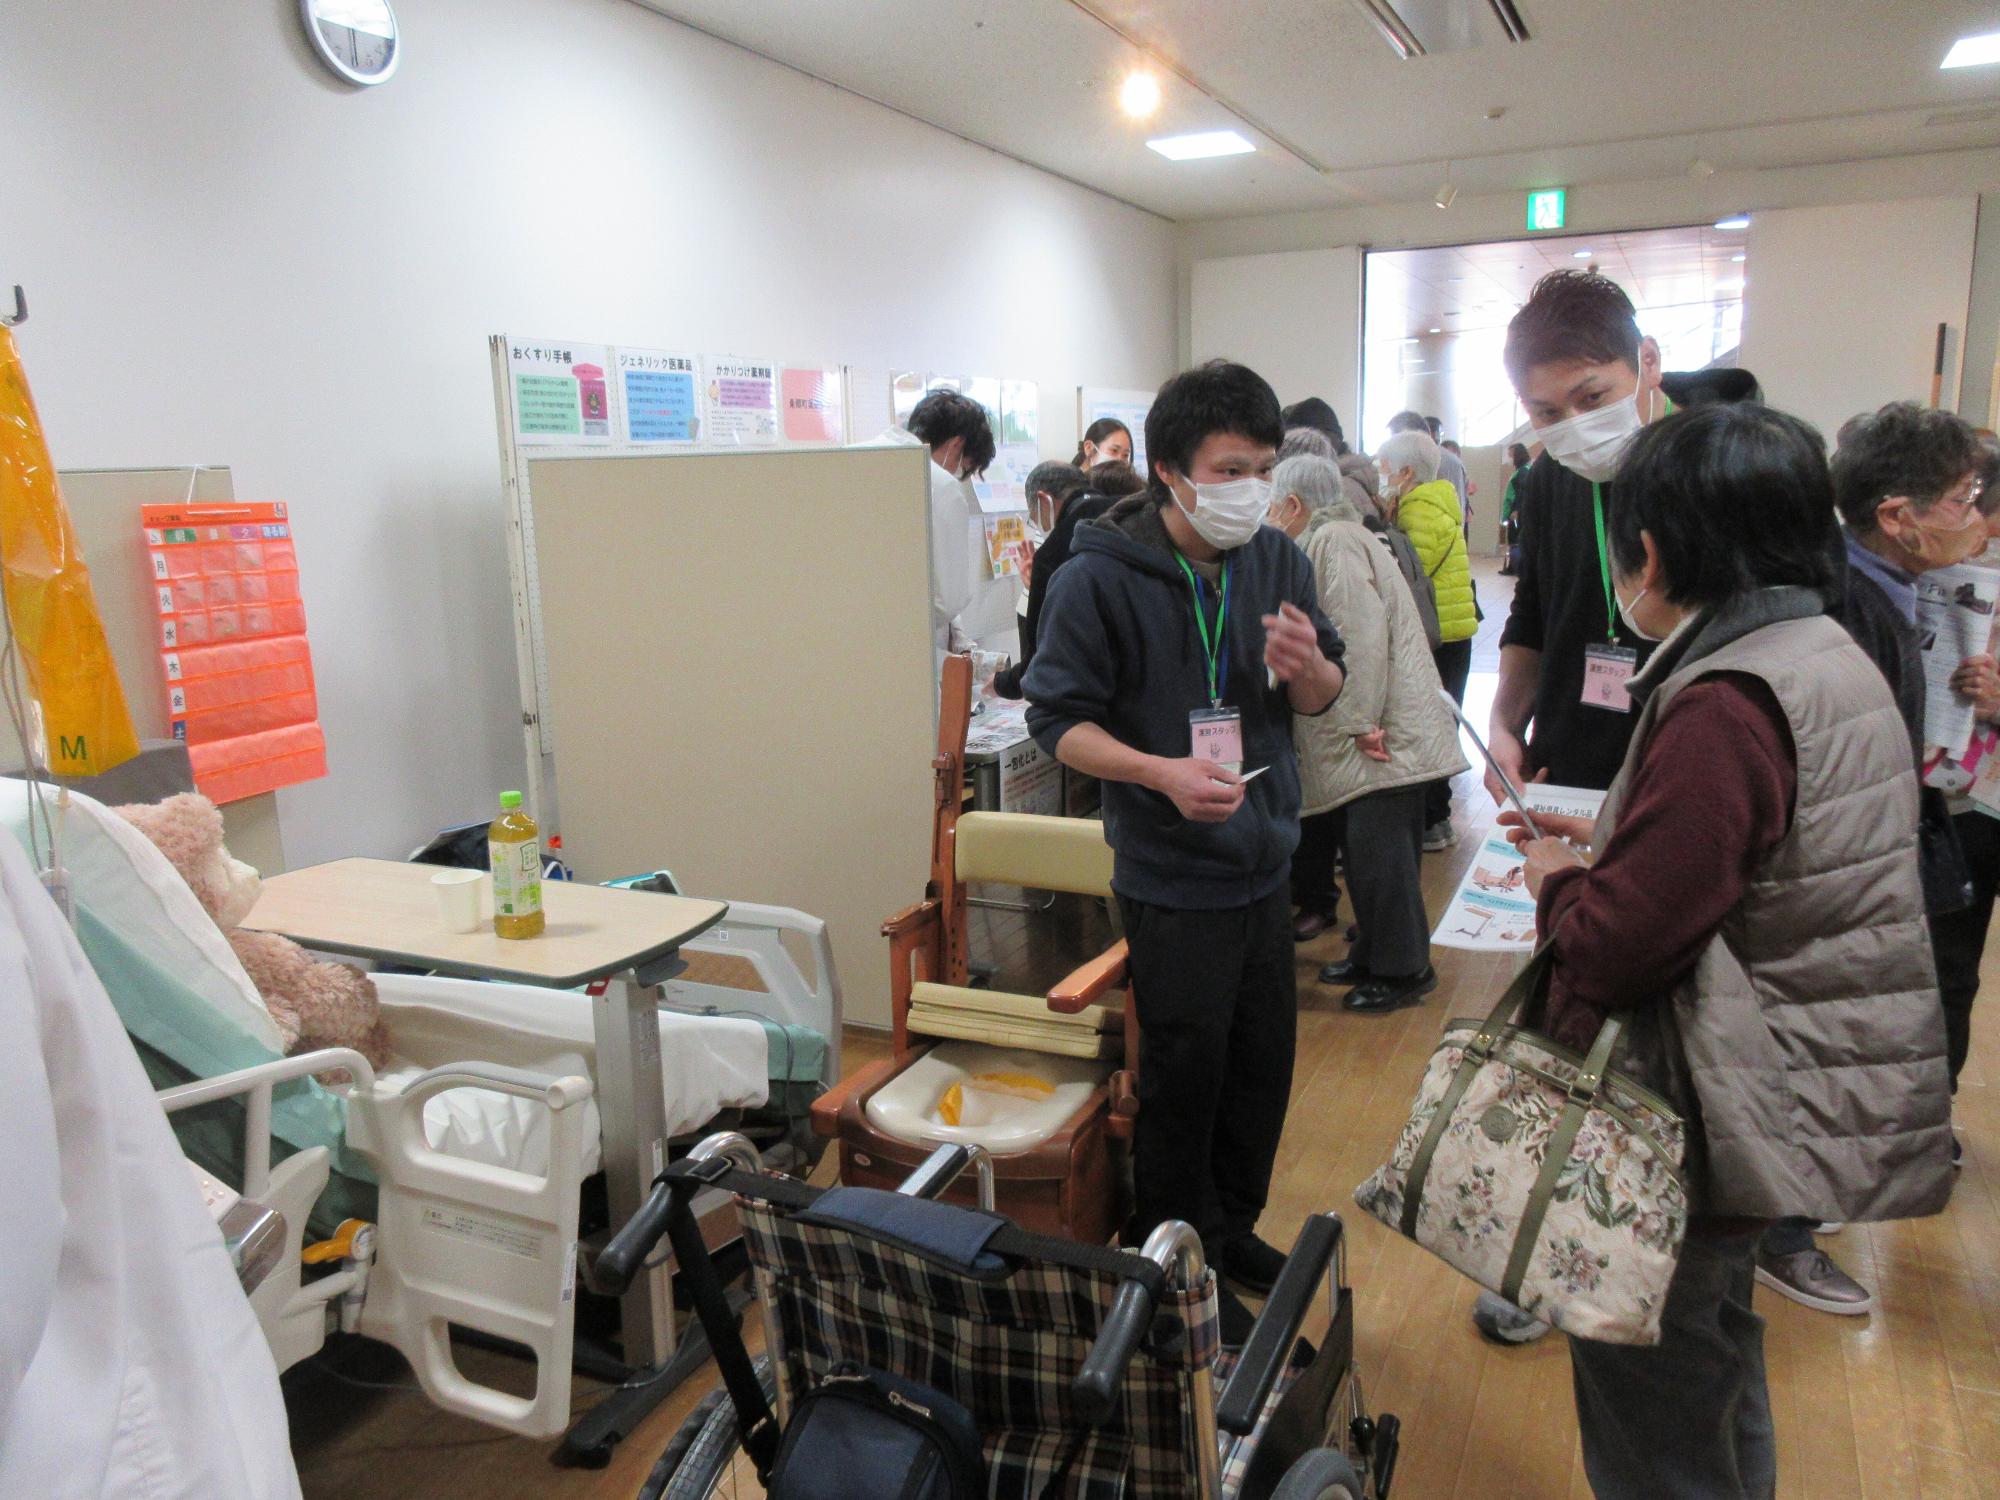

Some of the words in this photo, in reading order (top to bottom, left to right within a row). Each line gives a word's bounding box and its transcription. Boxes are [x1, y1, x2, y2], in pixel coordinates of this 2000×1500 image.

[513, 346, 573, 364] おくすり手帳
[620, 354, 693, 371] ジェネリック医薬品
[716, 365, 772, 378] かかりつけ薬剤師
[157, 561, 165, 573] 月
[162, 594, 171, 606] 火
[165, 628, 175, 640] 水
[169, 661, 178, 673] 木
[173, 694, 183, 707] 金
[175, 728, 184, 738] 土
[60, 735, 87, 760] M
[1004, 748, 1037, 771] 一包化とは
[1533, 803, 1592, 819] 福祉用具レンタル品
